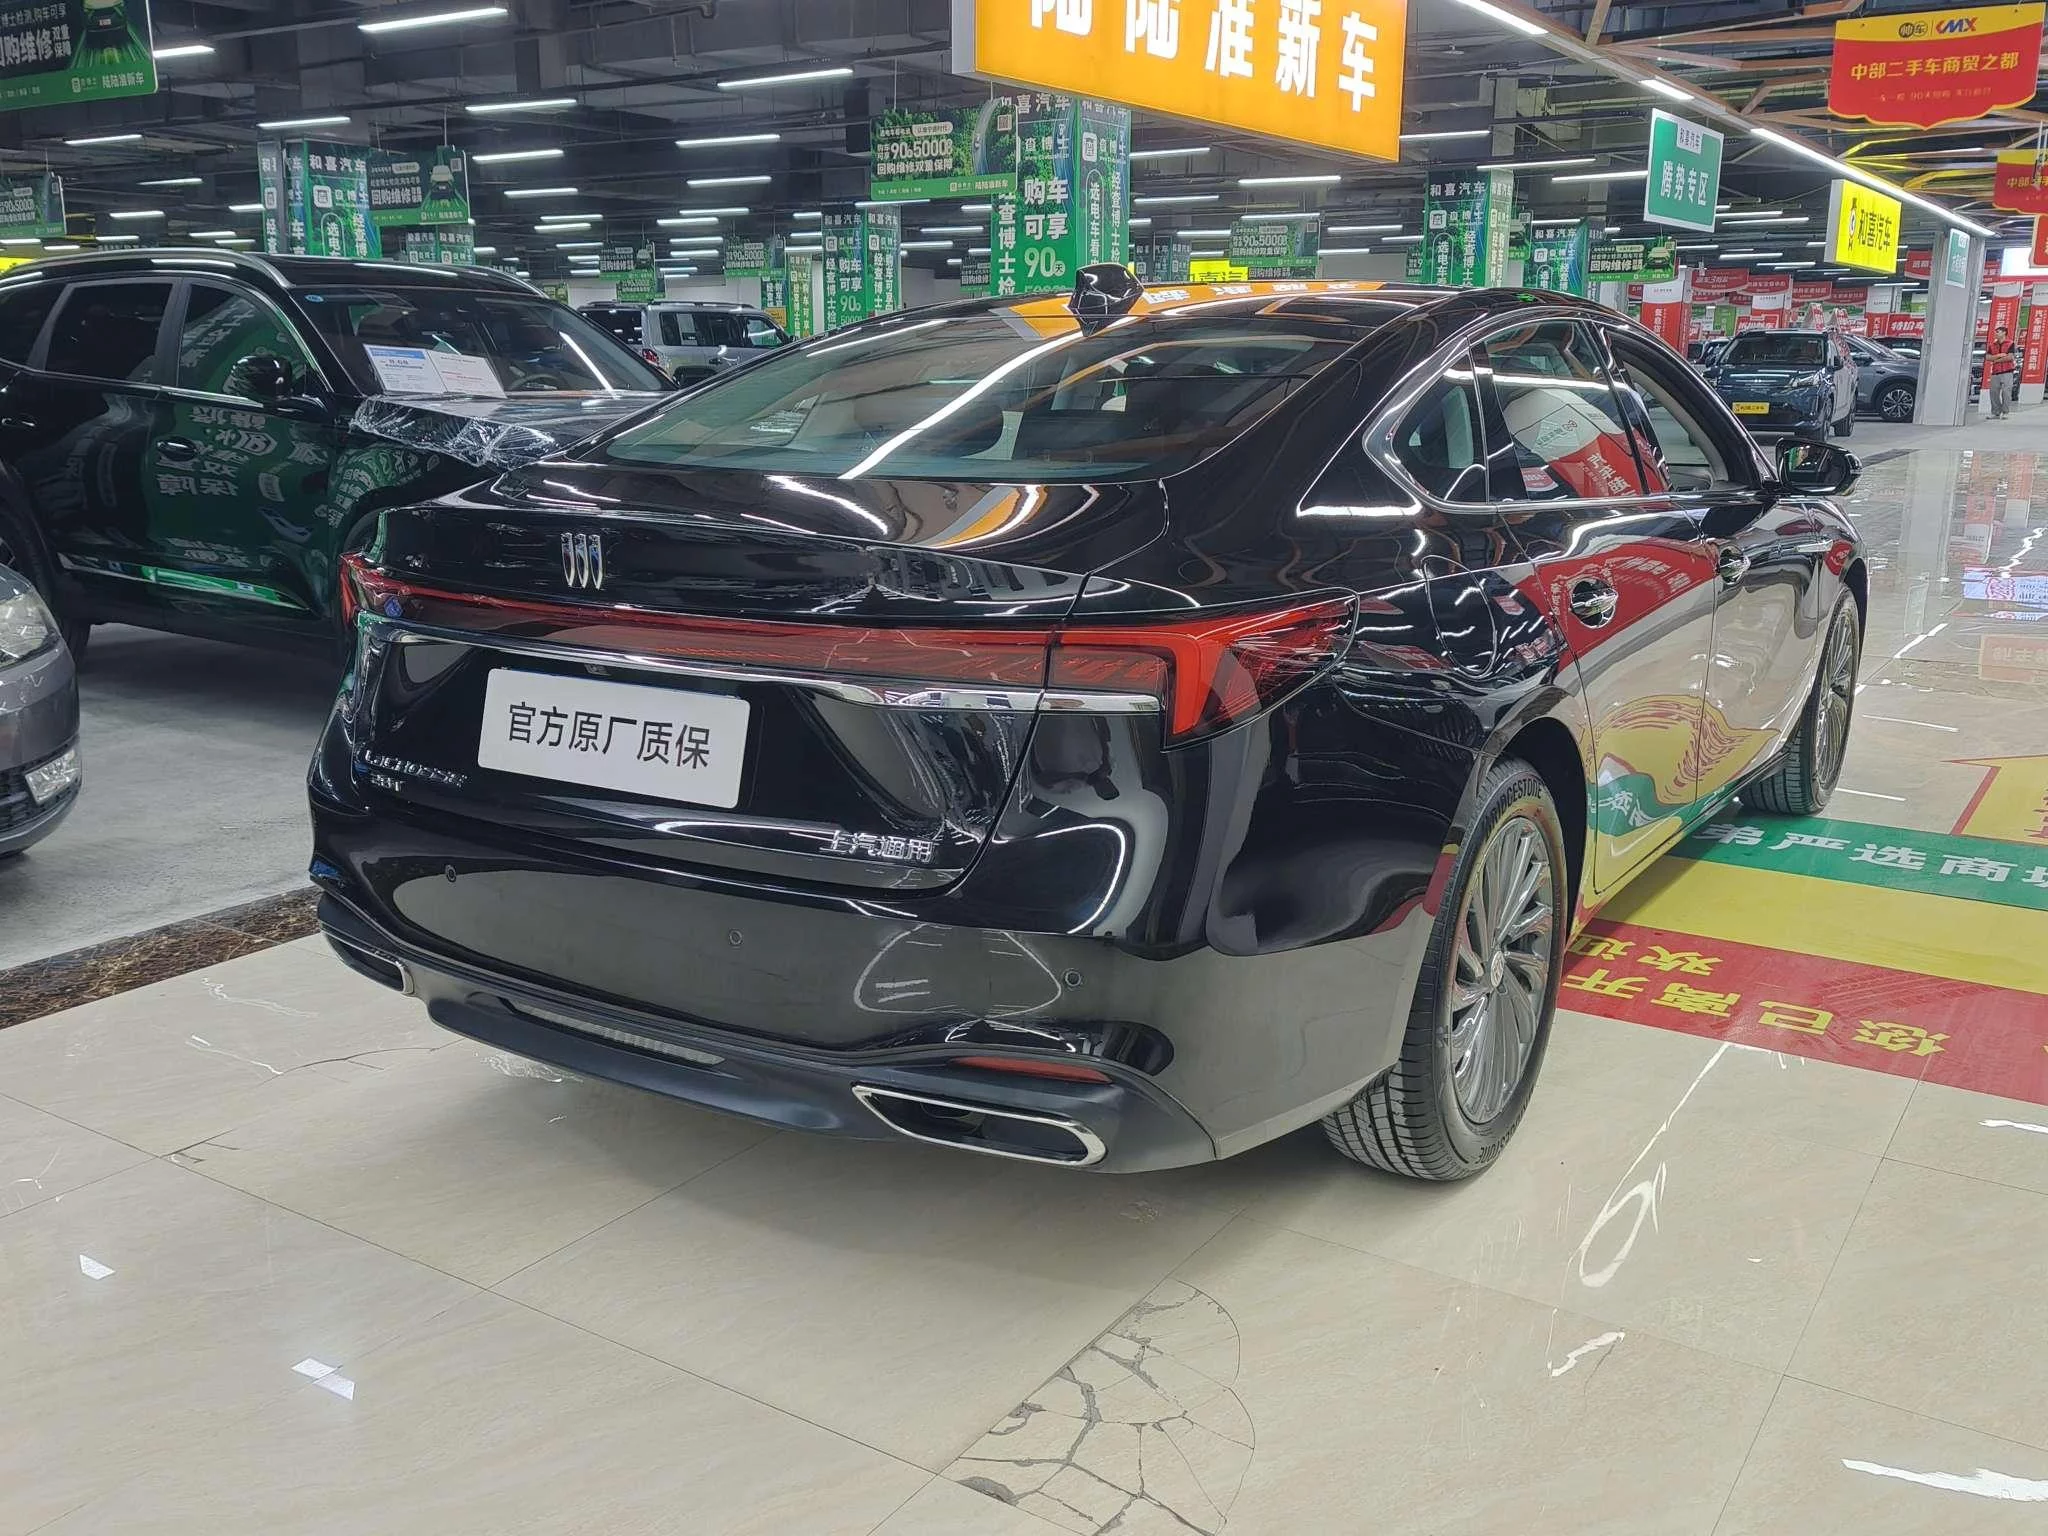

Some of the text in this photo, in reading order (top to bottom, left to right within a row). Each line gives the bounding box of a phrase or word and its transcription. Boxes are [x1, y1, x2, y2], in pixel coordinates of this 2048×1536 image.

[1851, 51, 2020, 80] 中部二手车商贸之都
[309, 155, 366, 173] 和喜汽车
[877, 158, 952, 175] 回购维修双重保障
[1024, 177, 1069, 206] 购车
[1430, 181, 1486, 197] 和喜汽车
[1661, 160, 1709, 207] 腾势专区
[824, 214, 862, 226] 和喜汽车
[1024, 213, 1069, 241] 可享
[1534, 228, 1577, 240] 和喜汽车
[1858, 208, 1893, 252] 和喜汽车
[998, 193, 1017, 295] 查博士检
[839, 258, 862, 273] 购车
[1024, 247, 1066, 278] 90天
[839, 278, 862, 292] 可享
[508, 701, 711, 770] 官方原厂质保
[819, 829, 934, 864] 上汽通用
[1562, 968, 1952, 1057] 您已离开
